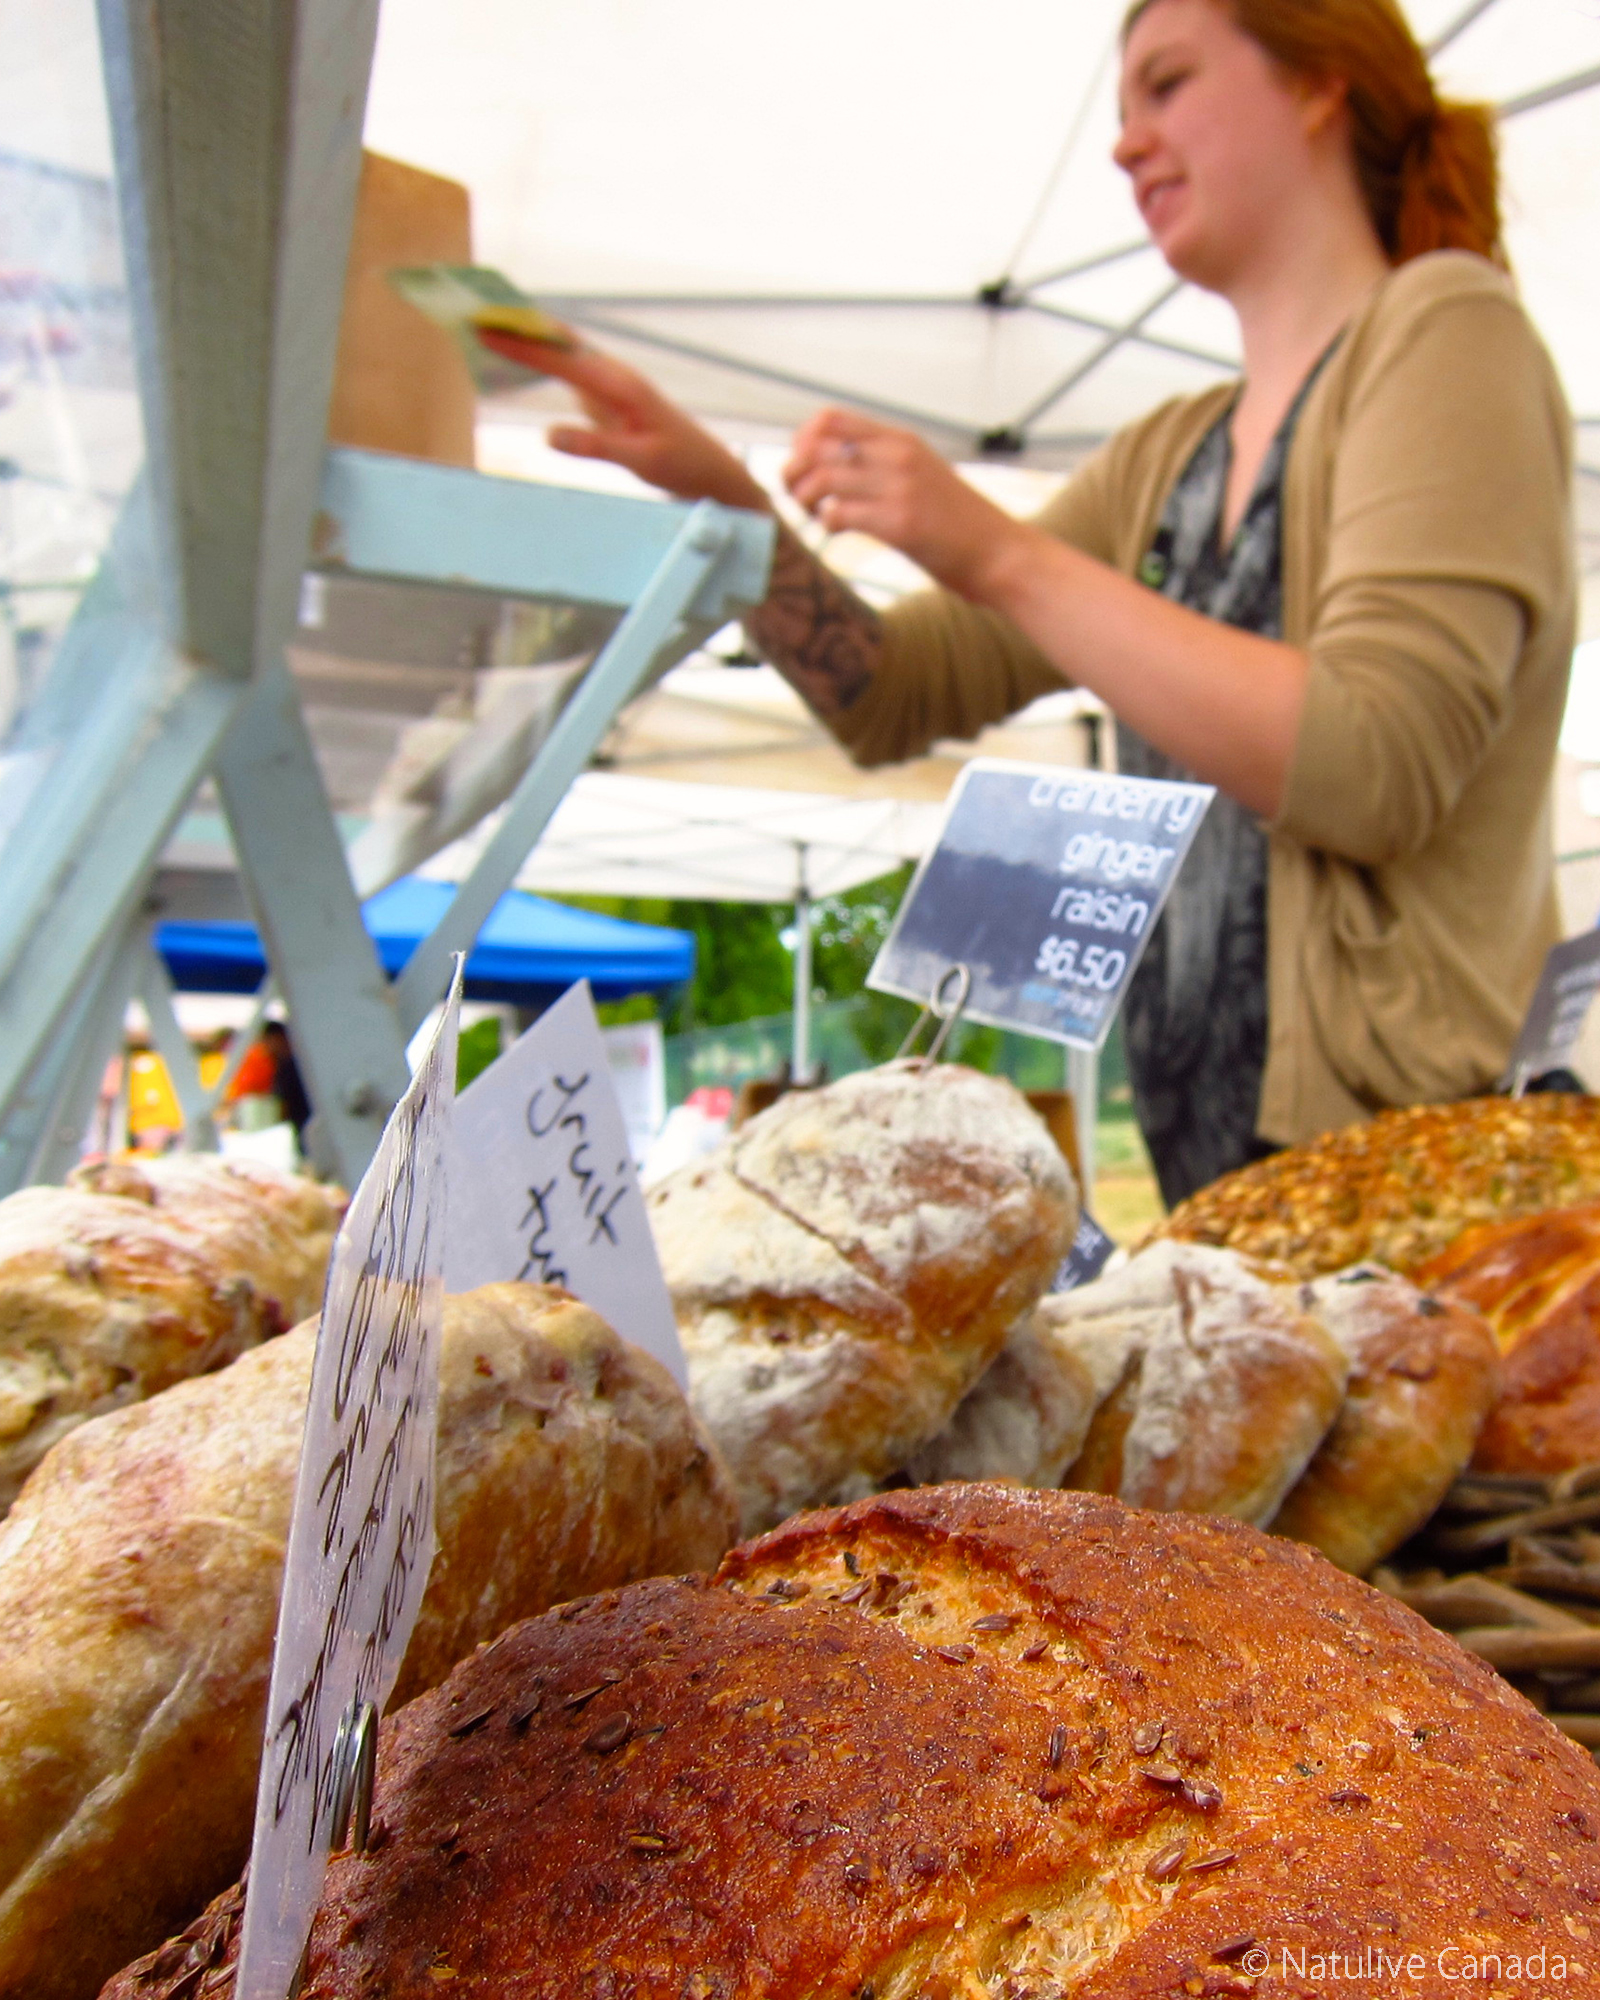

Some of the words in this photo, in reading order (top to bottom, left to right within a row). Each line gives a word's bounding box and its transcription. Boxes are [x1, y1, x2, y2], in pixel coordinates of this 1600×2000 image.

[1028, 776, 1198, 834] cranberry
[1059, 831, 1175, 880] ginger
[1051, 886, 1150, 936] raisin
[1035, 935, 1126, 991] $6.50
[527, 1072, 628, 1245] fruit
